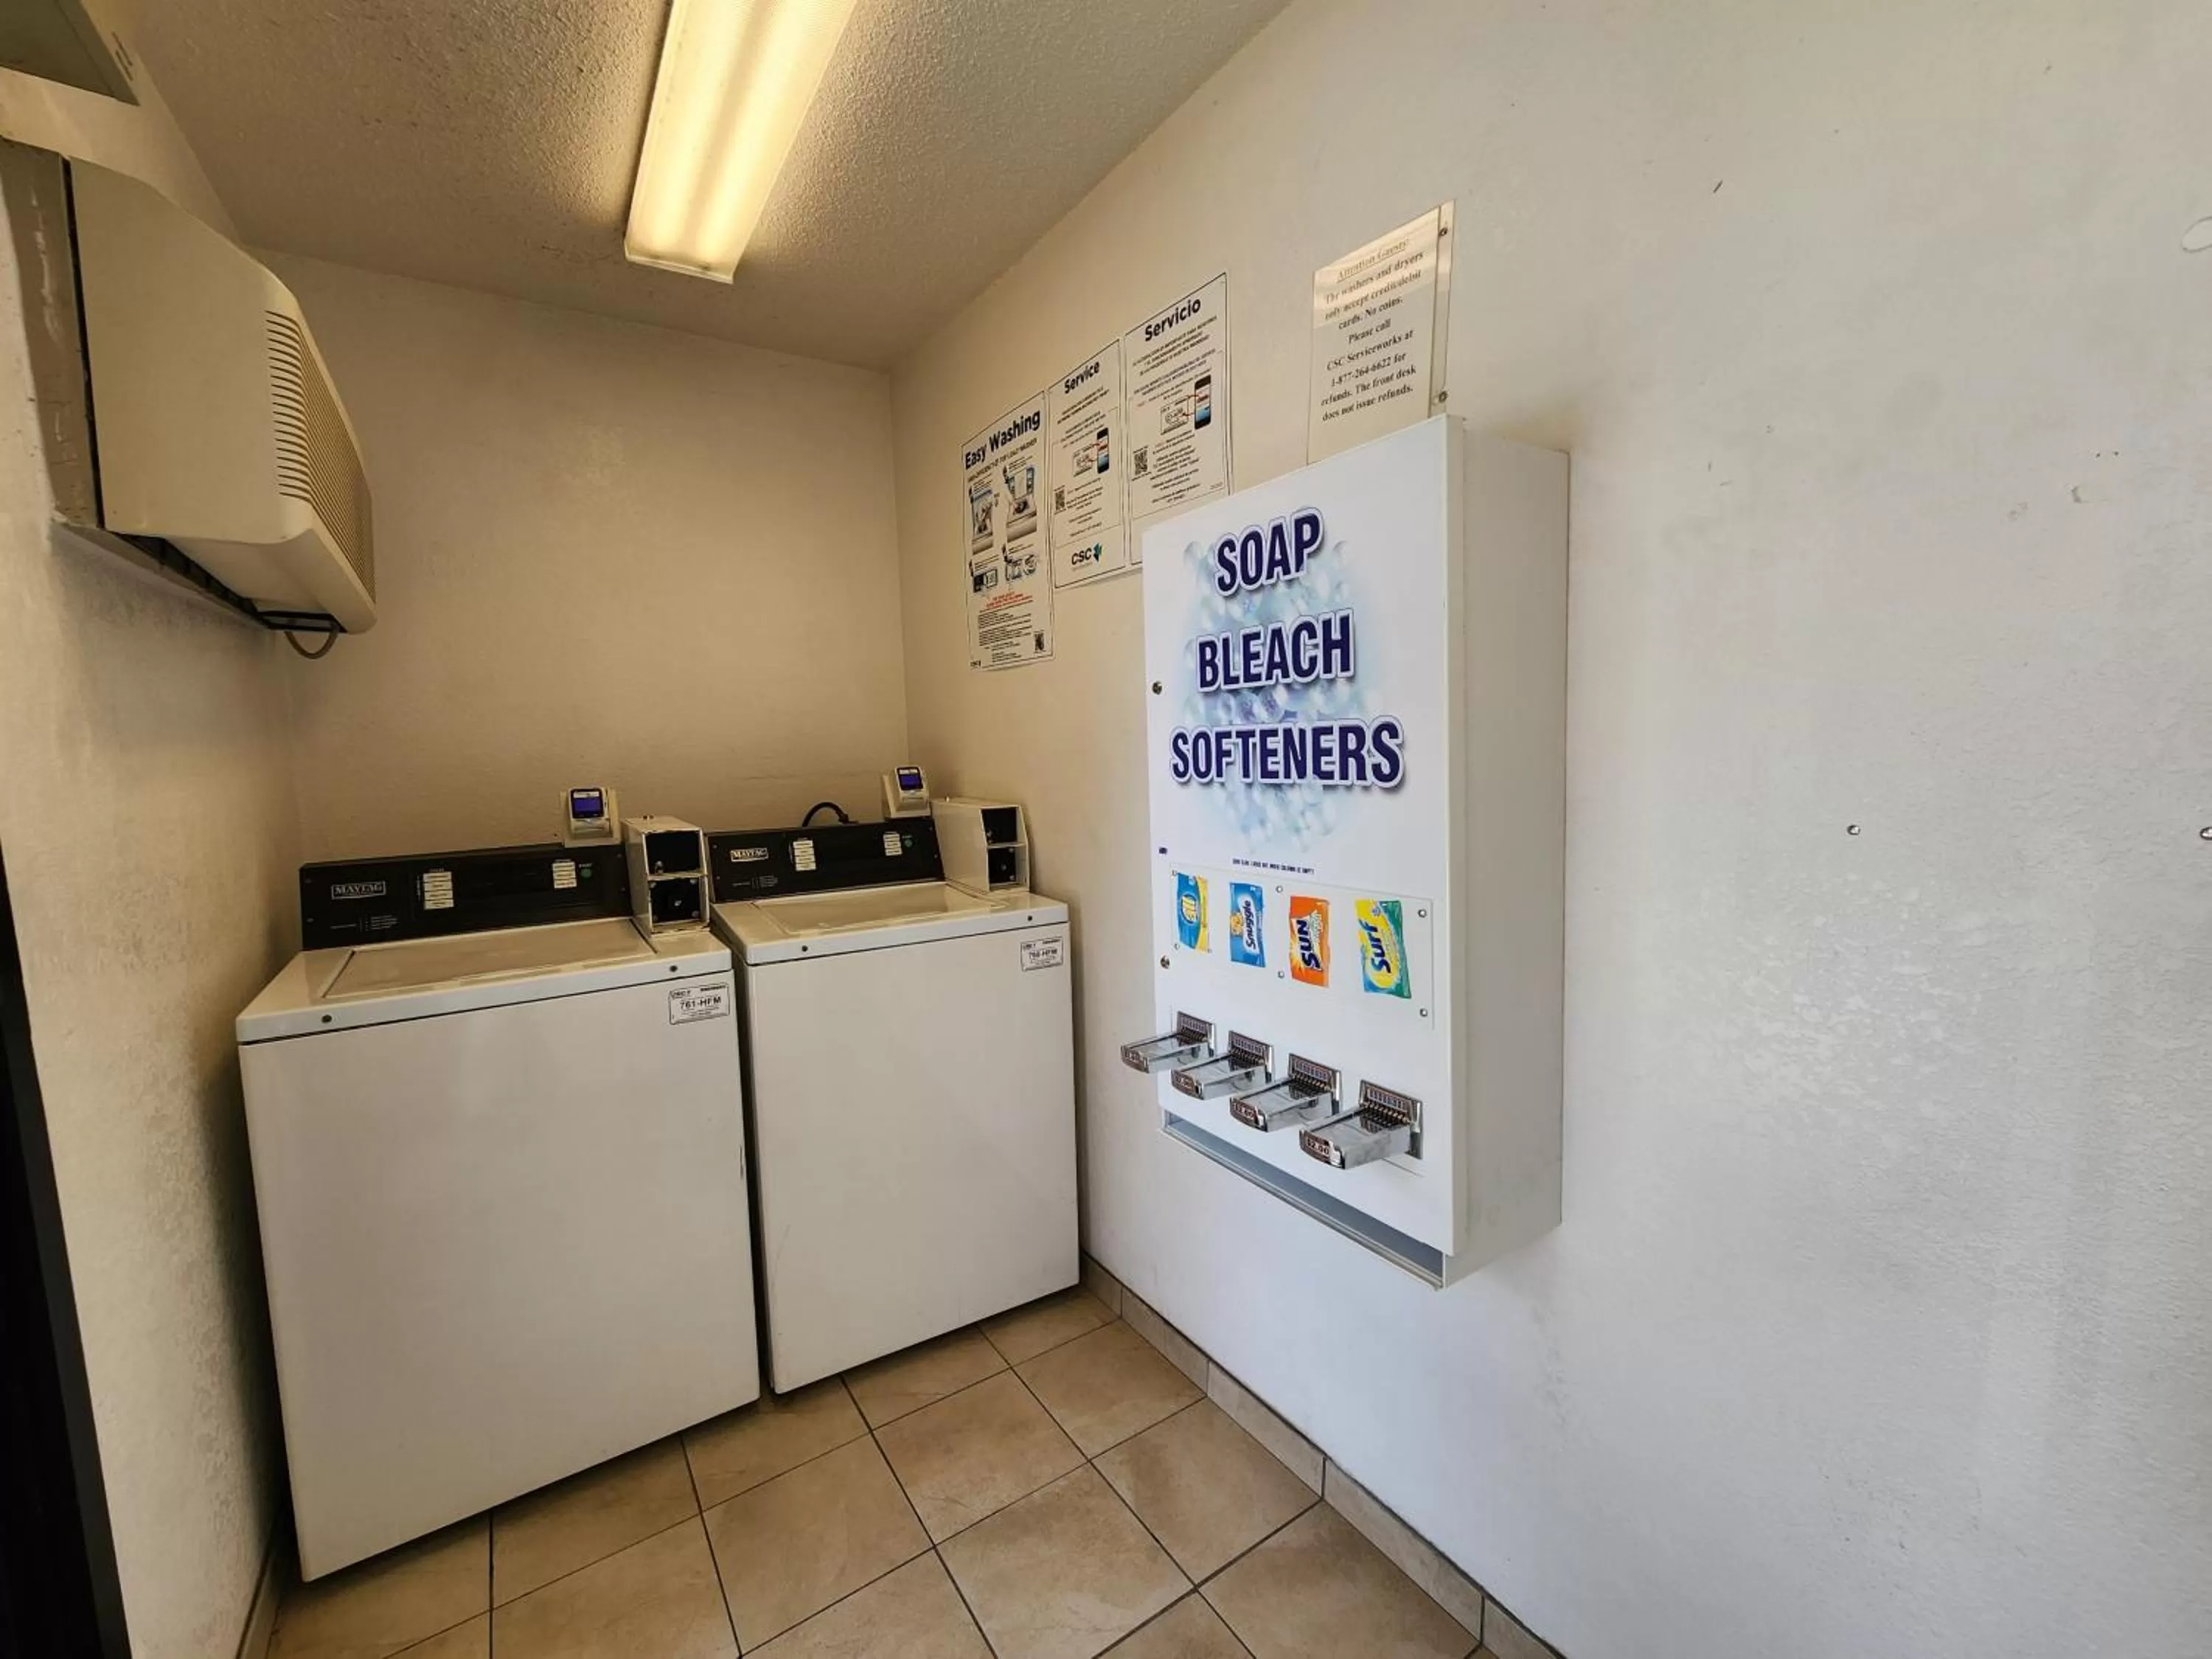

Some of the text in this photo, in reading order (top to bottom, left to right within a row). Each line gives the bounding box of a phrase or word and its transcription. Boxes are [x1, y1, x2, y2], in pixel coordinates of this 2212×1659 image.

[1325, 251, 1423, 304] The washers and dryers
[1145, 299, 1201, 341] Servicio
[1325, 307, 1340, 319] only
[1343, 293, 1369, 311] accept
[1339, 296, 1403, 329] cards. No coins.
[1327, 330, 1413, 370] CSC Serviceworks at
[1348, 319, 1391, 344] Please call
[1065, 361, 1099, 394] Service
[1394, 352, 1406, 363] for
[1321, 364, 1416, 406] refunds. The front desk
[1323, 384, 1413, 421] does not issue refunds.
[965, 443, 987, 470] Easy
[989, 410, 1040, 452] Washing
[1071, 548, 1092, 566] CSC
[1215, 510, 1321, 594] SOAP
[1196, 612, 1352, 689] BLEACH
[1170, 720, 1402, 785] SOFTENERS
[732, 848, 767, 858] MAYTAG
[334, 883, 383, 894] MAYTAG
[1243, 900, 1256, 950] Snuggle
[1358, 918, 1391, 973] Surf
